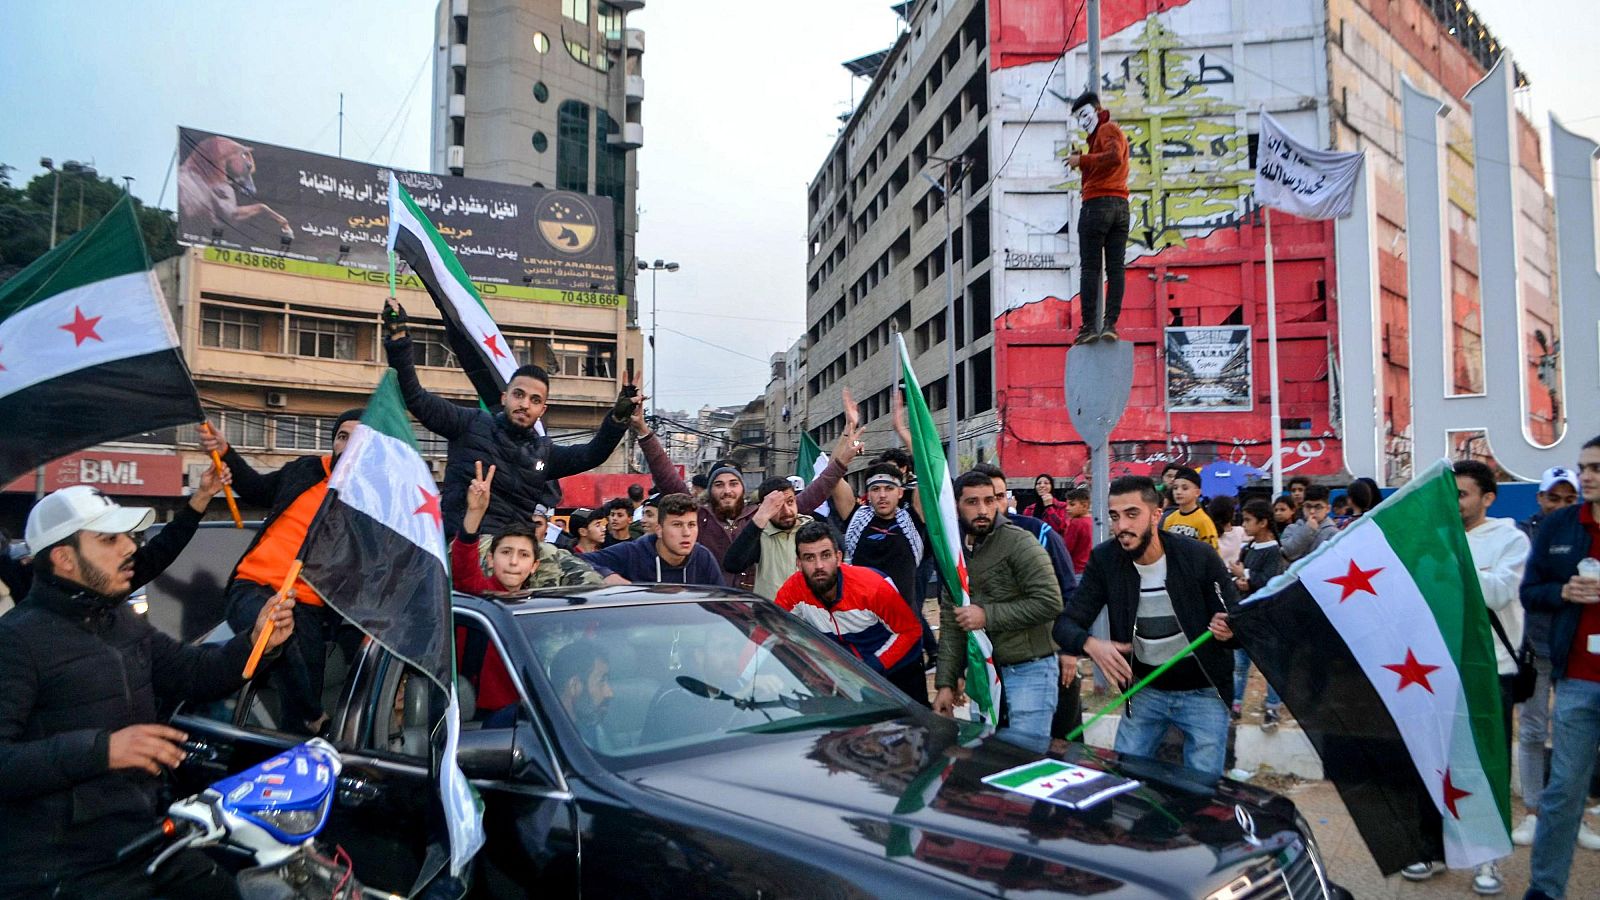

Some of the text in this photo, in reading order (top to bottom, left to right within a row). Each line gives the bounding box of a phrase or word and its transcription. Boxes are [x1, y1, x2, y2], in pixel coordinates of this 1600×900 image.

[214, 248, 229, 262] 70
[234, 253, 259, 267] 438
[262, 256, 286, 271] 666
[523, 257, 614, 271] LEVANT ARABIANS
[561, 291, 620, 305] 70 438 666
[80, 459, 144, 484] BML
